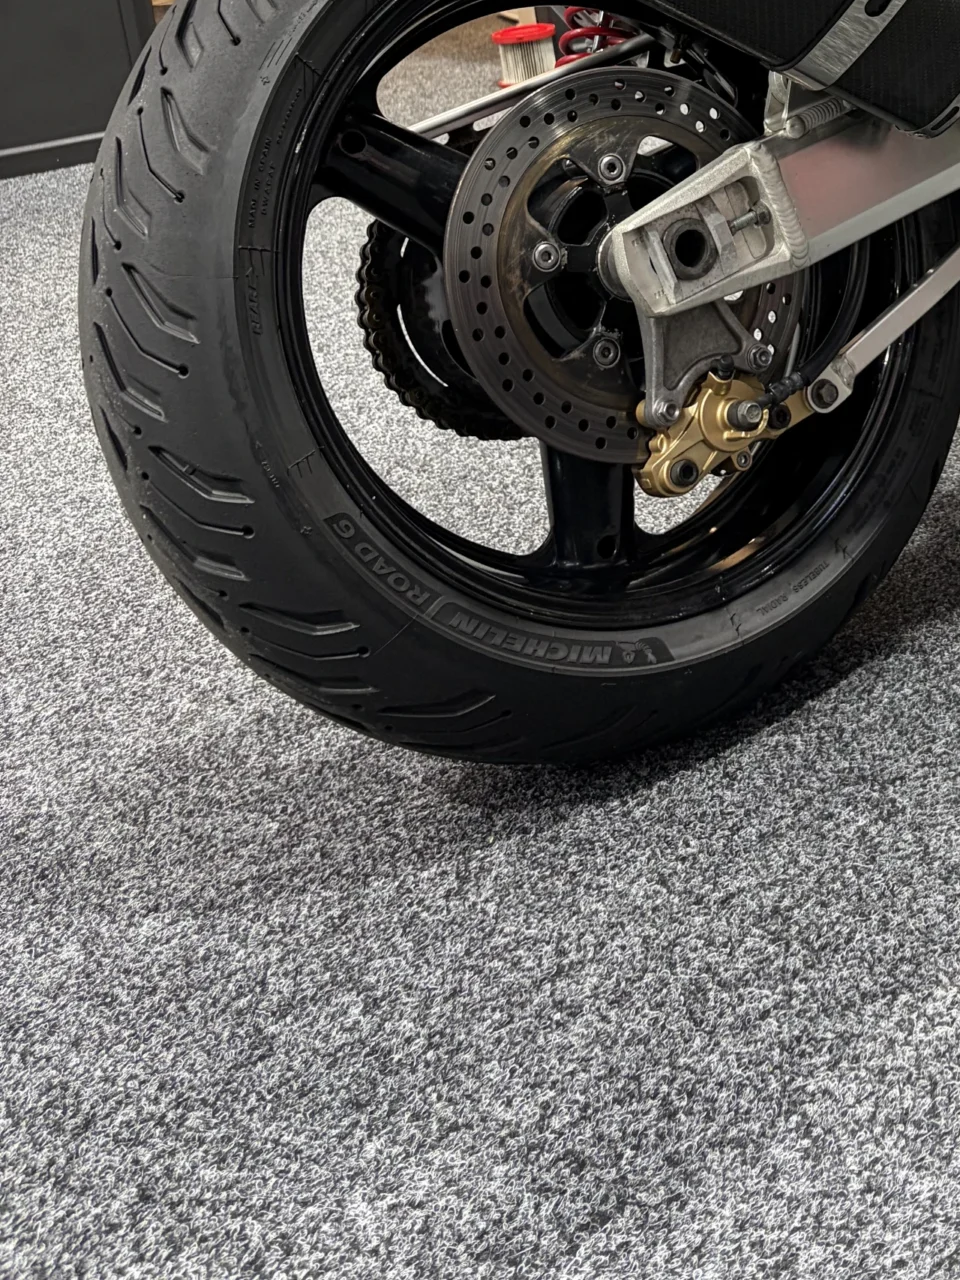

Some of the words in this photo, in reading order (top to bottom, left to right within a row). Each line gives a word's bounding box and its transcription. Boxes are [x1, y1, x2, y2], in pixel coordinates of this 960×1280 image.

[332, 519, 355, 539] 6
[354, 542, 431, 606] ROAD
[792, 561, 830, 593] TUBELESS
[756, 595, 788, 616] RADIAL
[448, 612, 613, 665] MICHELIN
